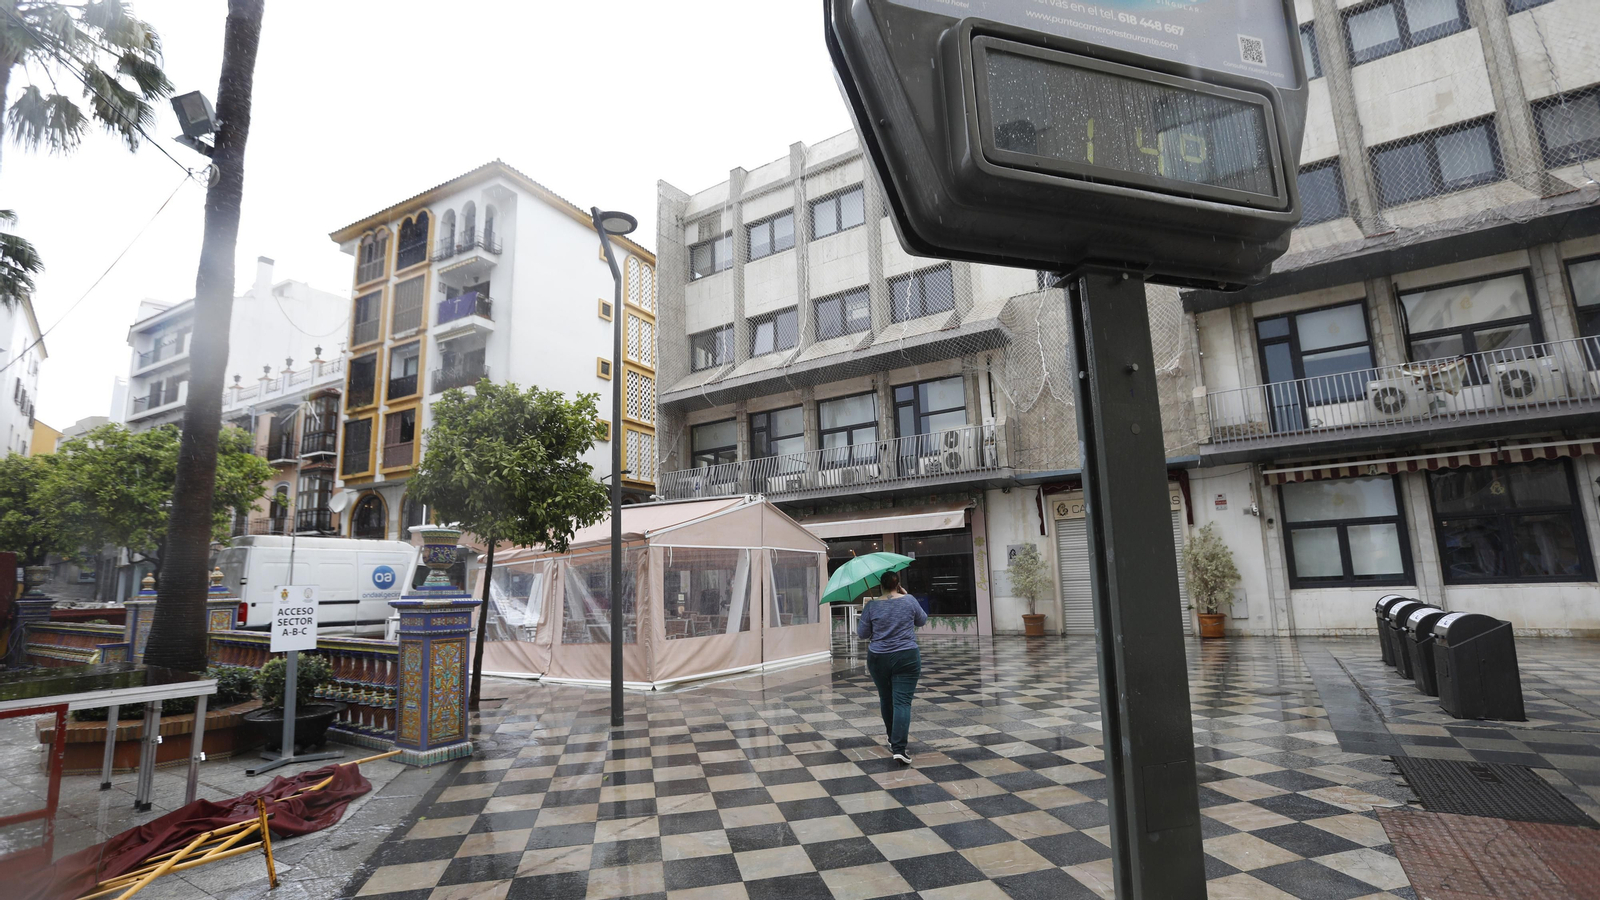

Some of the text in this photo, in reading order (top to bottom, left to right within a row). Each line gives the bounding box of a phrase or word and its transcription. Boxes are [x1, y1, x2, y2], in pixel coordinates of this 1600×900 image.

[1070, 3, 1086, 13] en
[1087, 6, 1098, 16] el
[1100, 8, 1117, 21] tel.
[1117, 12, 1138, 26] 618
[1139, 17, 1163, 31] 448
[1164, 23, 1185, 36] 667
[1025, 9, 1179, 50] www.puntacarnerorestaurante.com
[277, 607, 314, 616] ACCESO
[277, 617, 313, 627] SECTOR
[282, 627, 307, 636] A-B-C
